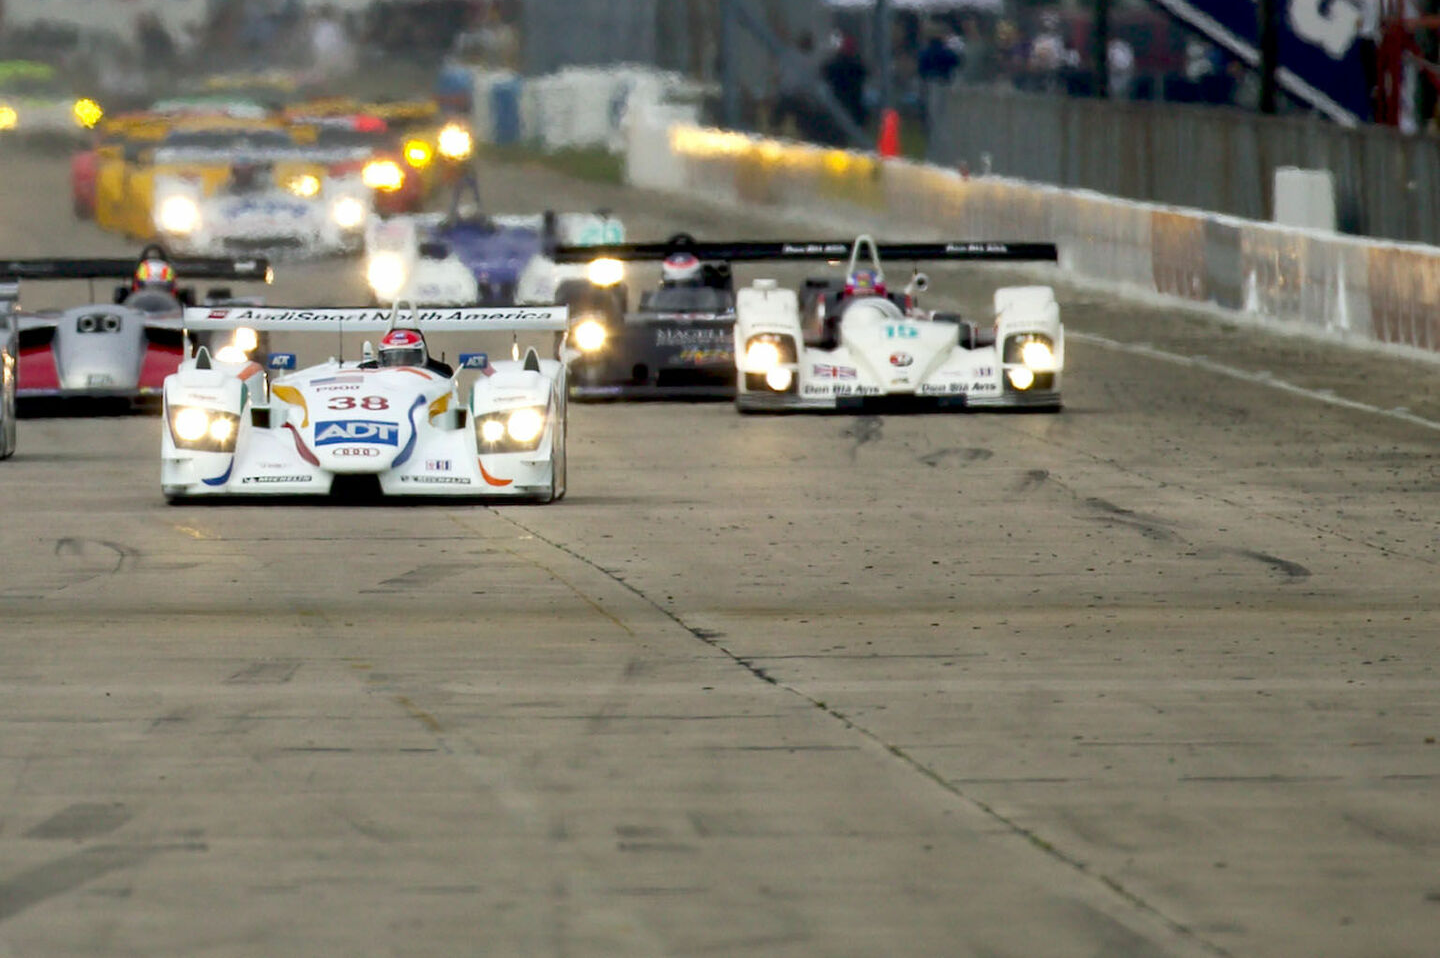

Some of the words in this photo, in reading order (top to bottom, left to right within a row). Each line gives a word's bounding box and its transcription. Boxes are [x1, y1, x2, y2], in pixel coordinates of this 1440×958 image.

[445, 310, 552, 321] America
[327, 395, 390, 410] 38
[315, 422, 398, 441] ADT
